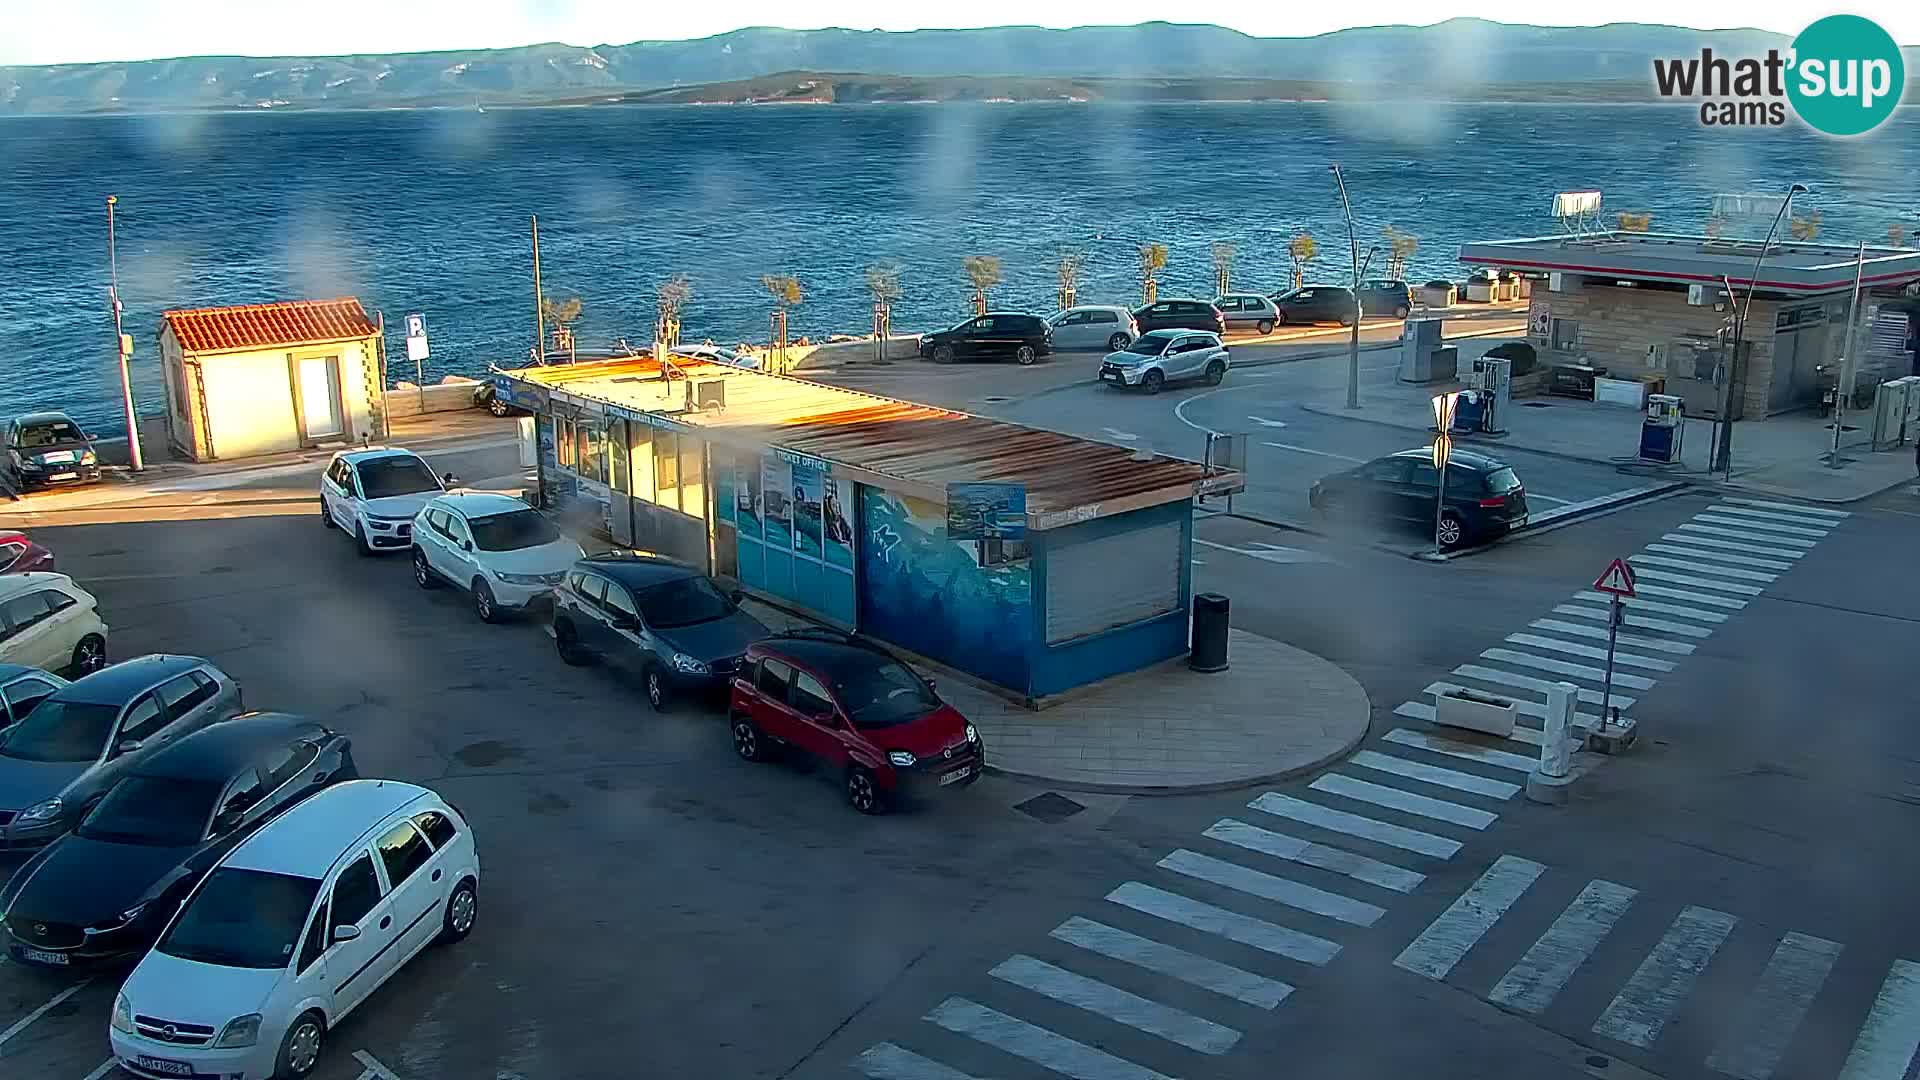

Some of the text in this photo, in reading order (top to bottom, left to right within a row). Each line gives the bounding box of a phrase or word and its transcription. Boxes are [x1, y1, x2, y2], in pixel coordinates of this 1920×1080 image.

[410, 317, 423, 336] P
[776, 450, 827, 472] TICKET OFFICE
